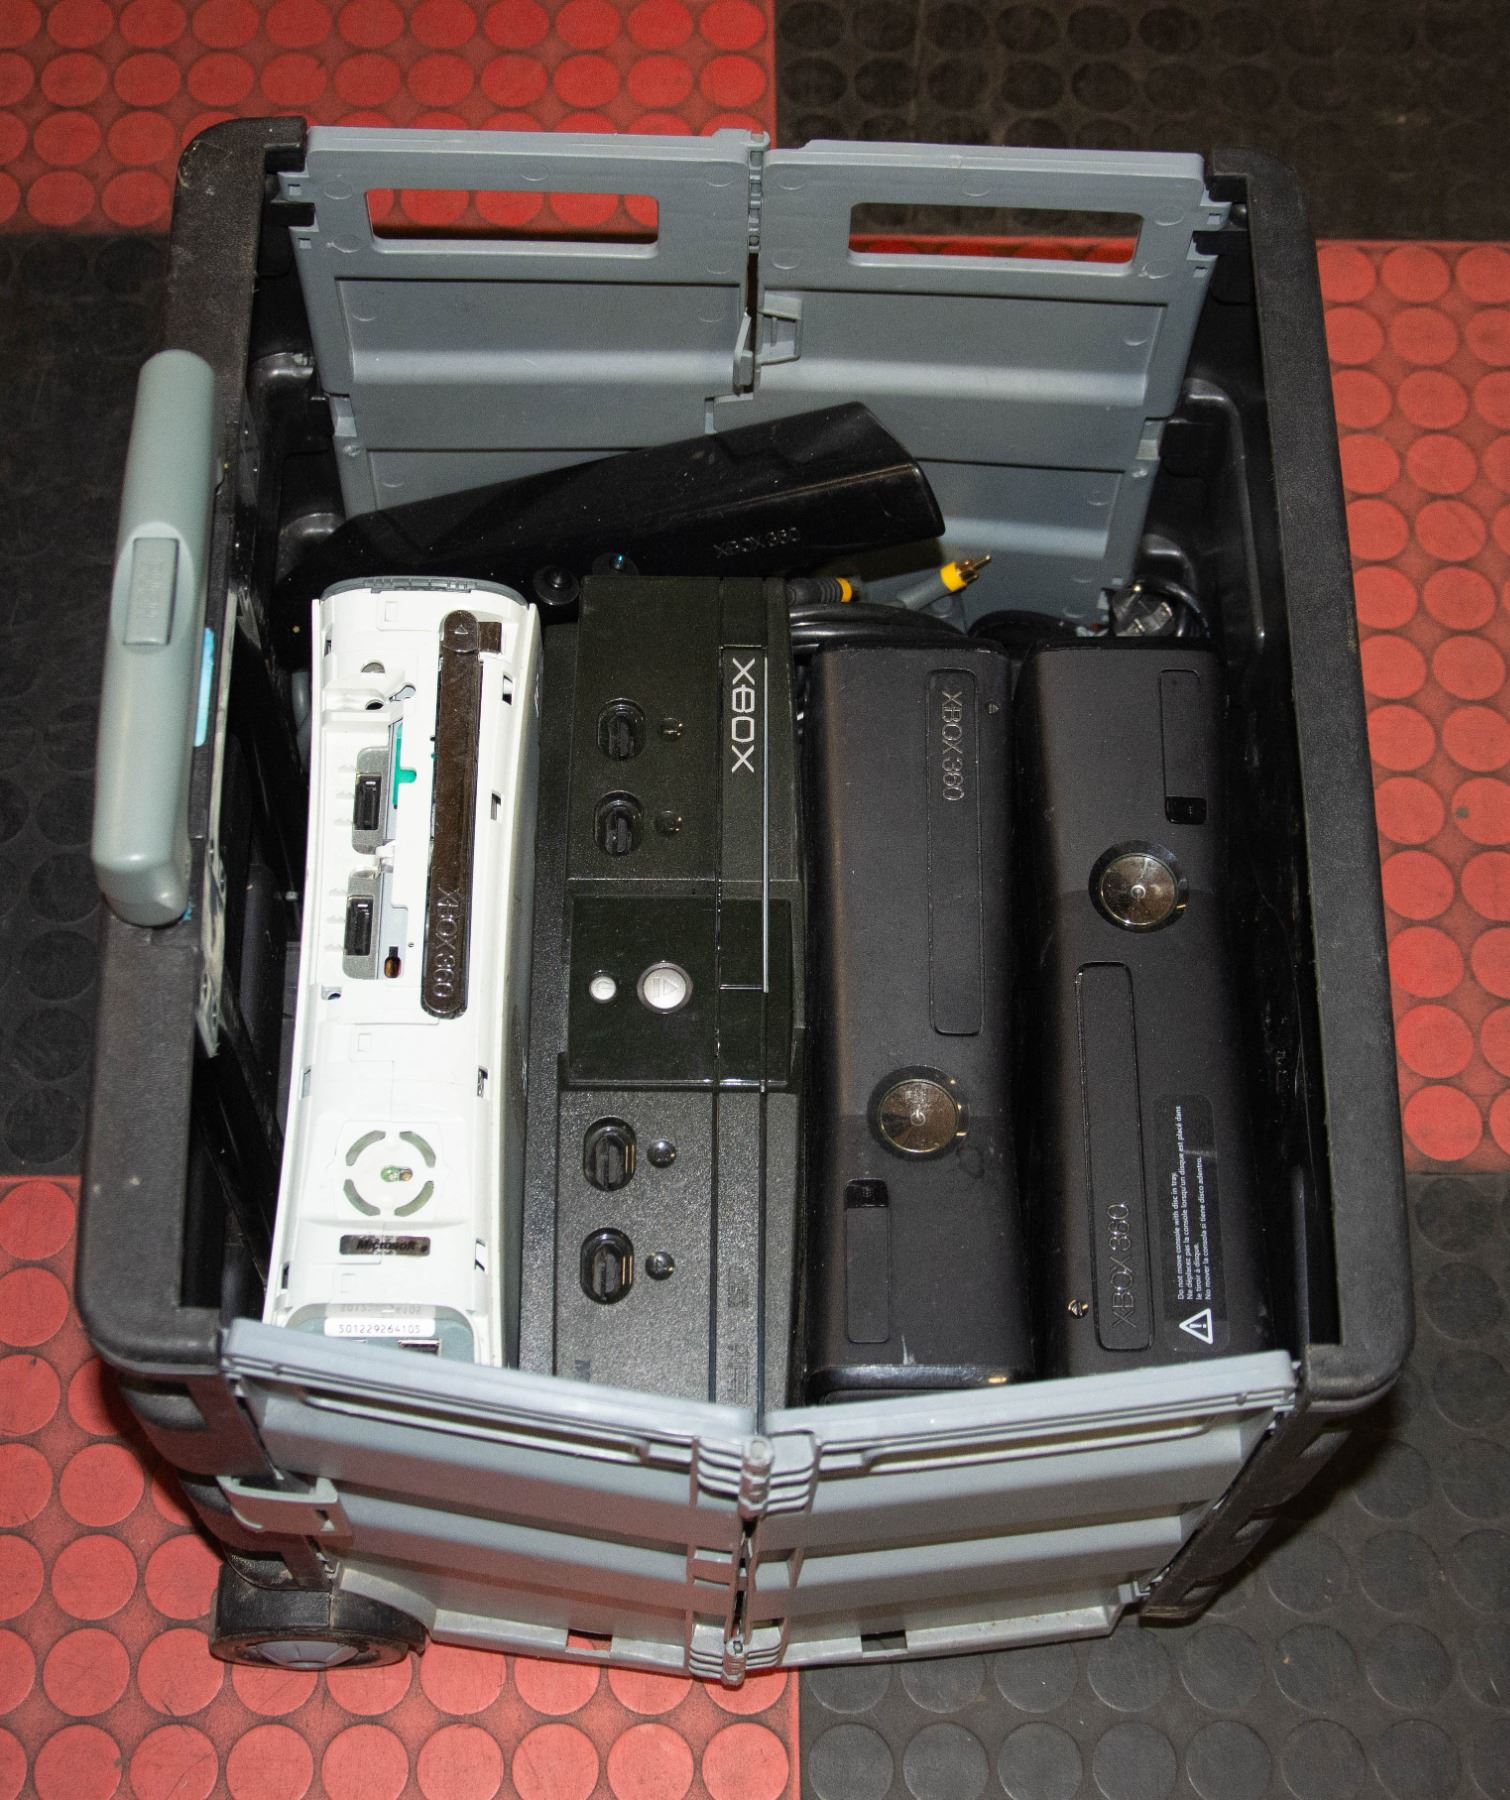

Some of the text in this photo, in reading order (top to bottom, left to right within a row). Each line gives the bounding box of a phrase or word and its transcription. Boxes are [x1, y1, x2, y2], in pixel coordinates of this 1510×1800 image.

[713, 527, 801, 559] XBOX 360
[731, 657, 755, 773] XBOX
[942, 691, 964, 800] XBOX 360
[432, 884, 461, 998] XBOX 360
[1176, 1122, 1184, 1141] placé
[1171, 1187, 1178, 1195] in
[1184, 1236, 1190, 1244] la
[1107, 1203, 1136, 1329] XBOX 360
[1203, 1257, 1209, 1265] la
[1178, 1288, 1184, 1300] Do
[1187, 1287, 1193, 1300] Ne
[1205, 1288, 1211, 1300] No
[339, 1324, 421, 1334] 501229264105
